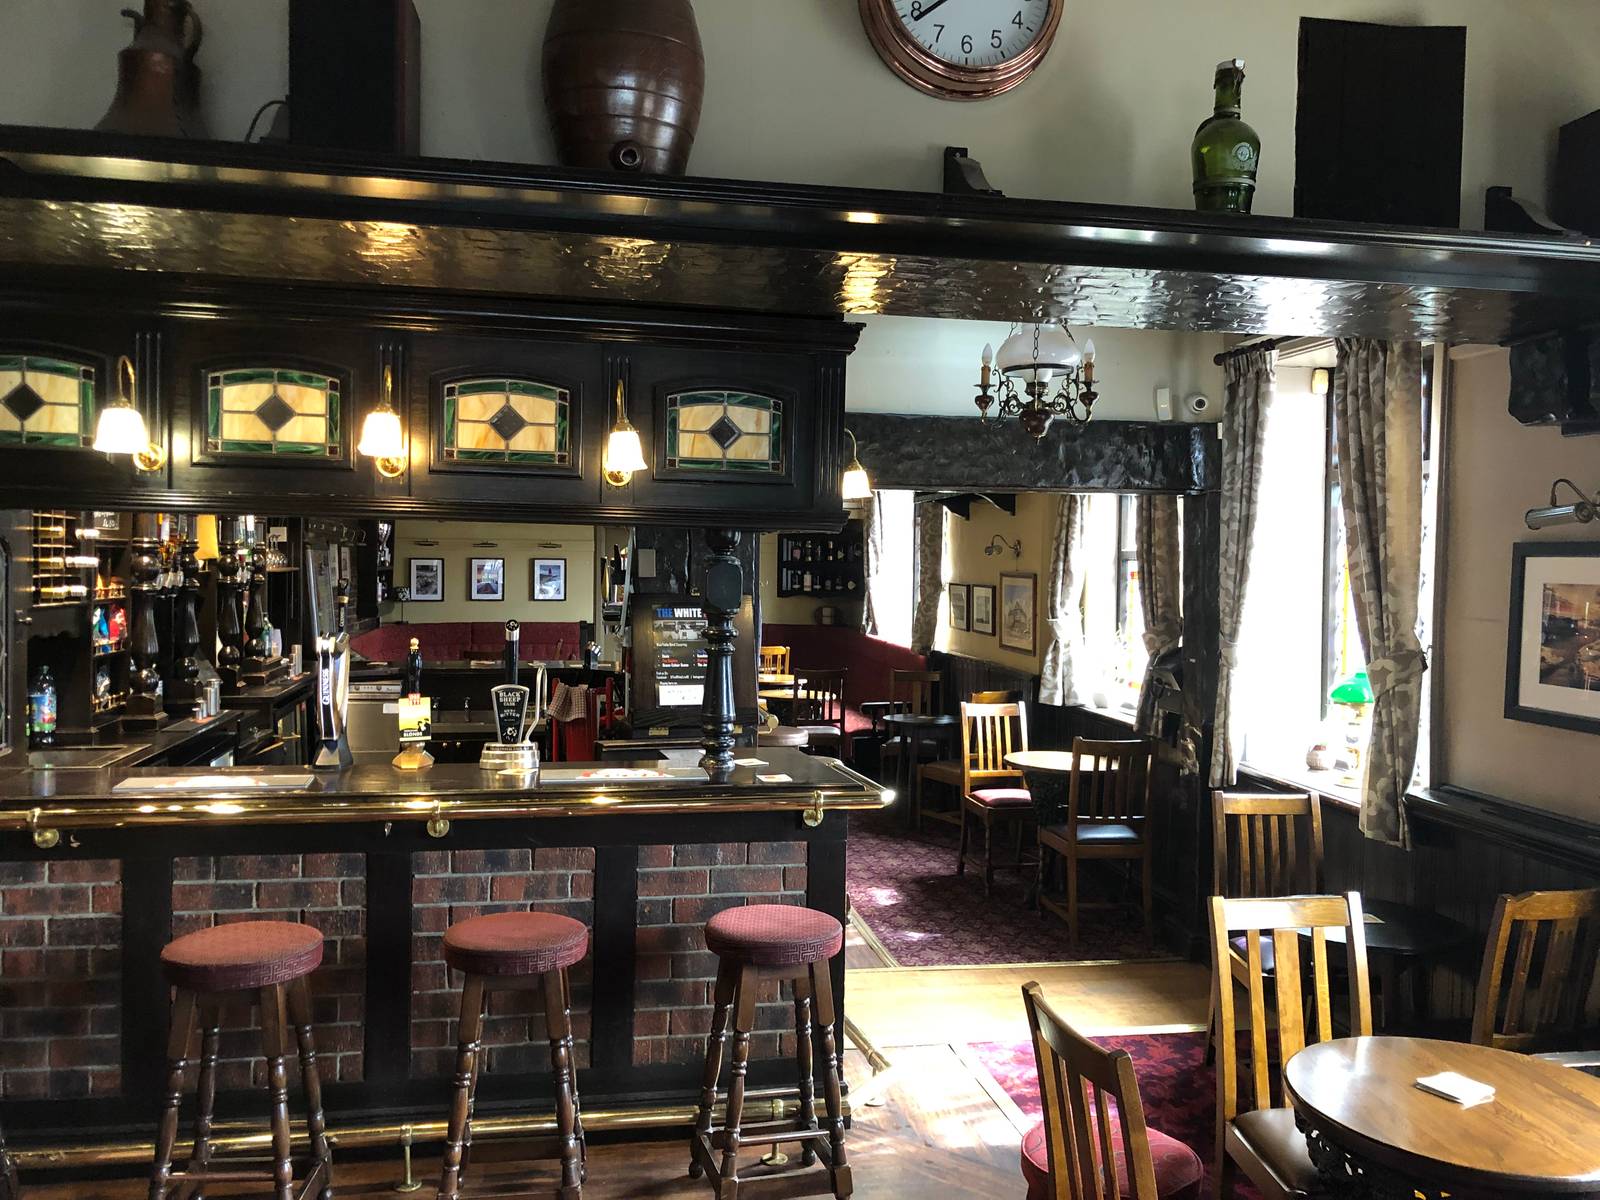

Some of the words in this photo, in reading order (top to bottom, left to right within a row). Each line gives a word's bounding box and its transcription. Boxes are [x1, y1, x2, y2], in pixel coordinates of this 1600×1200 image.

[911, 0, 922, 18] 8
[1012, 10, 1023, 30] 4
[933, 24, 945, 43] 7
[991, 30, 1002, 49] 5
[961, 35, 973, 54] 6
[656, 608, 673, 618] THE
[674, 608, 702, 618] WHITE
